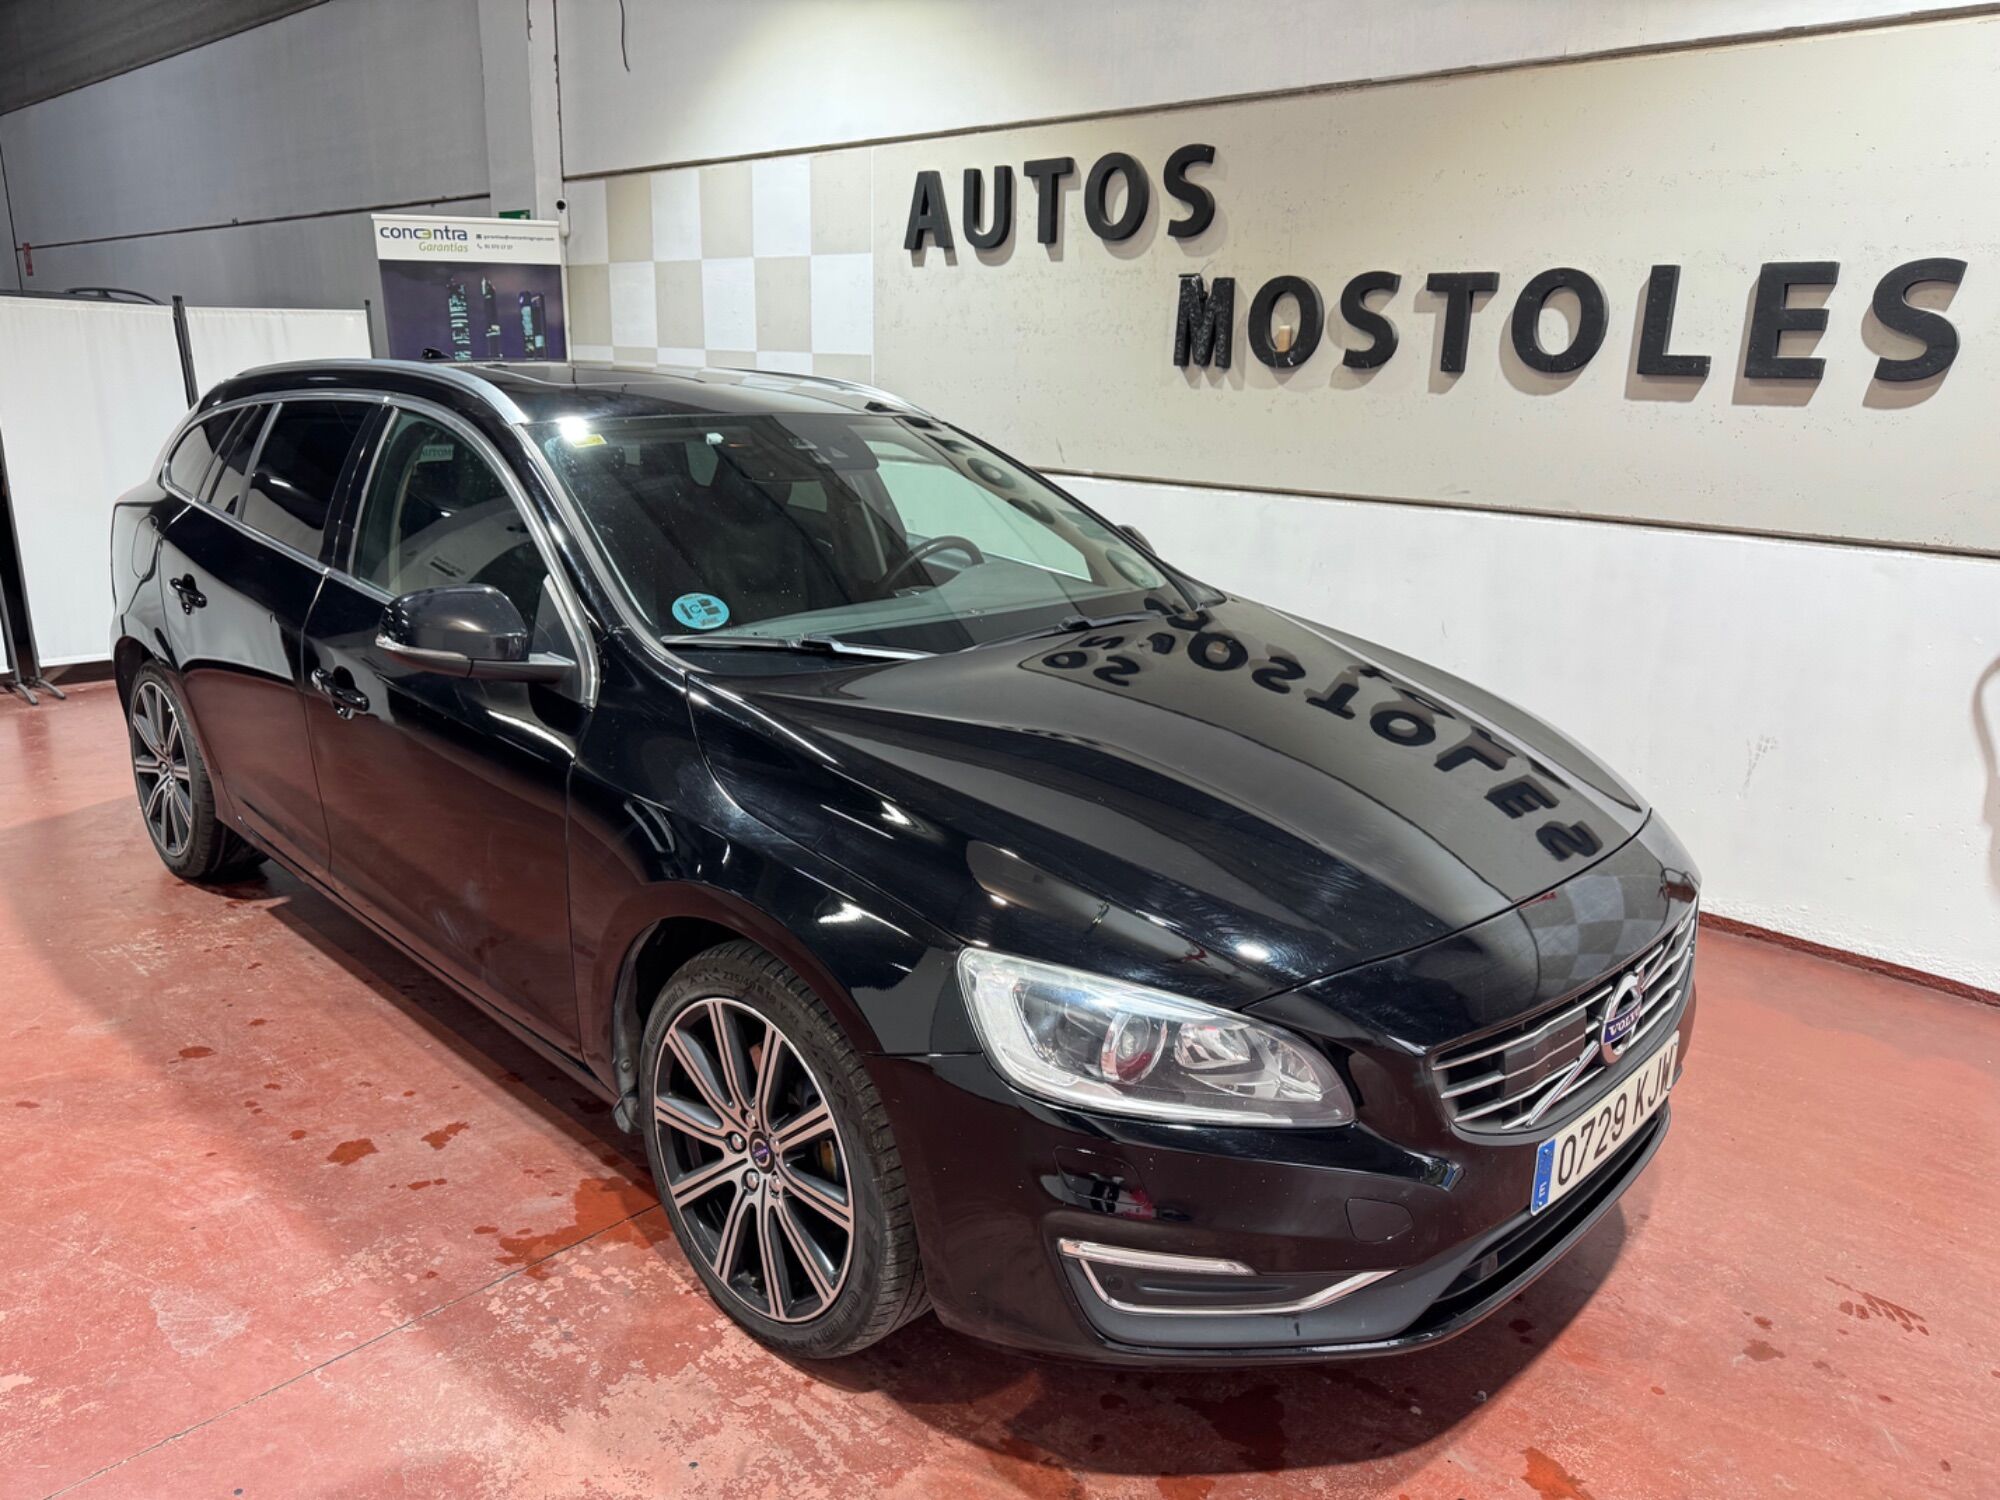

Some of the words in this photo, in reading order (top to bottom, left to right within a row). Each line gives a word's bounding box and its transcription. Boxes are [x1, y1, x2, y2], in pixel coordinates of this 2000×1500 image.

[379, 225, 469, 241] concentra
[904, 144, 1217, 252] AUTOS
[1174, 256, 1968, 384] MOSTOLES
[1557, 1093, 1628, 1186] 0729
